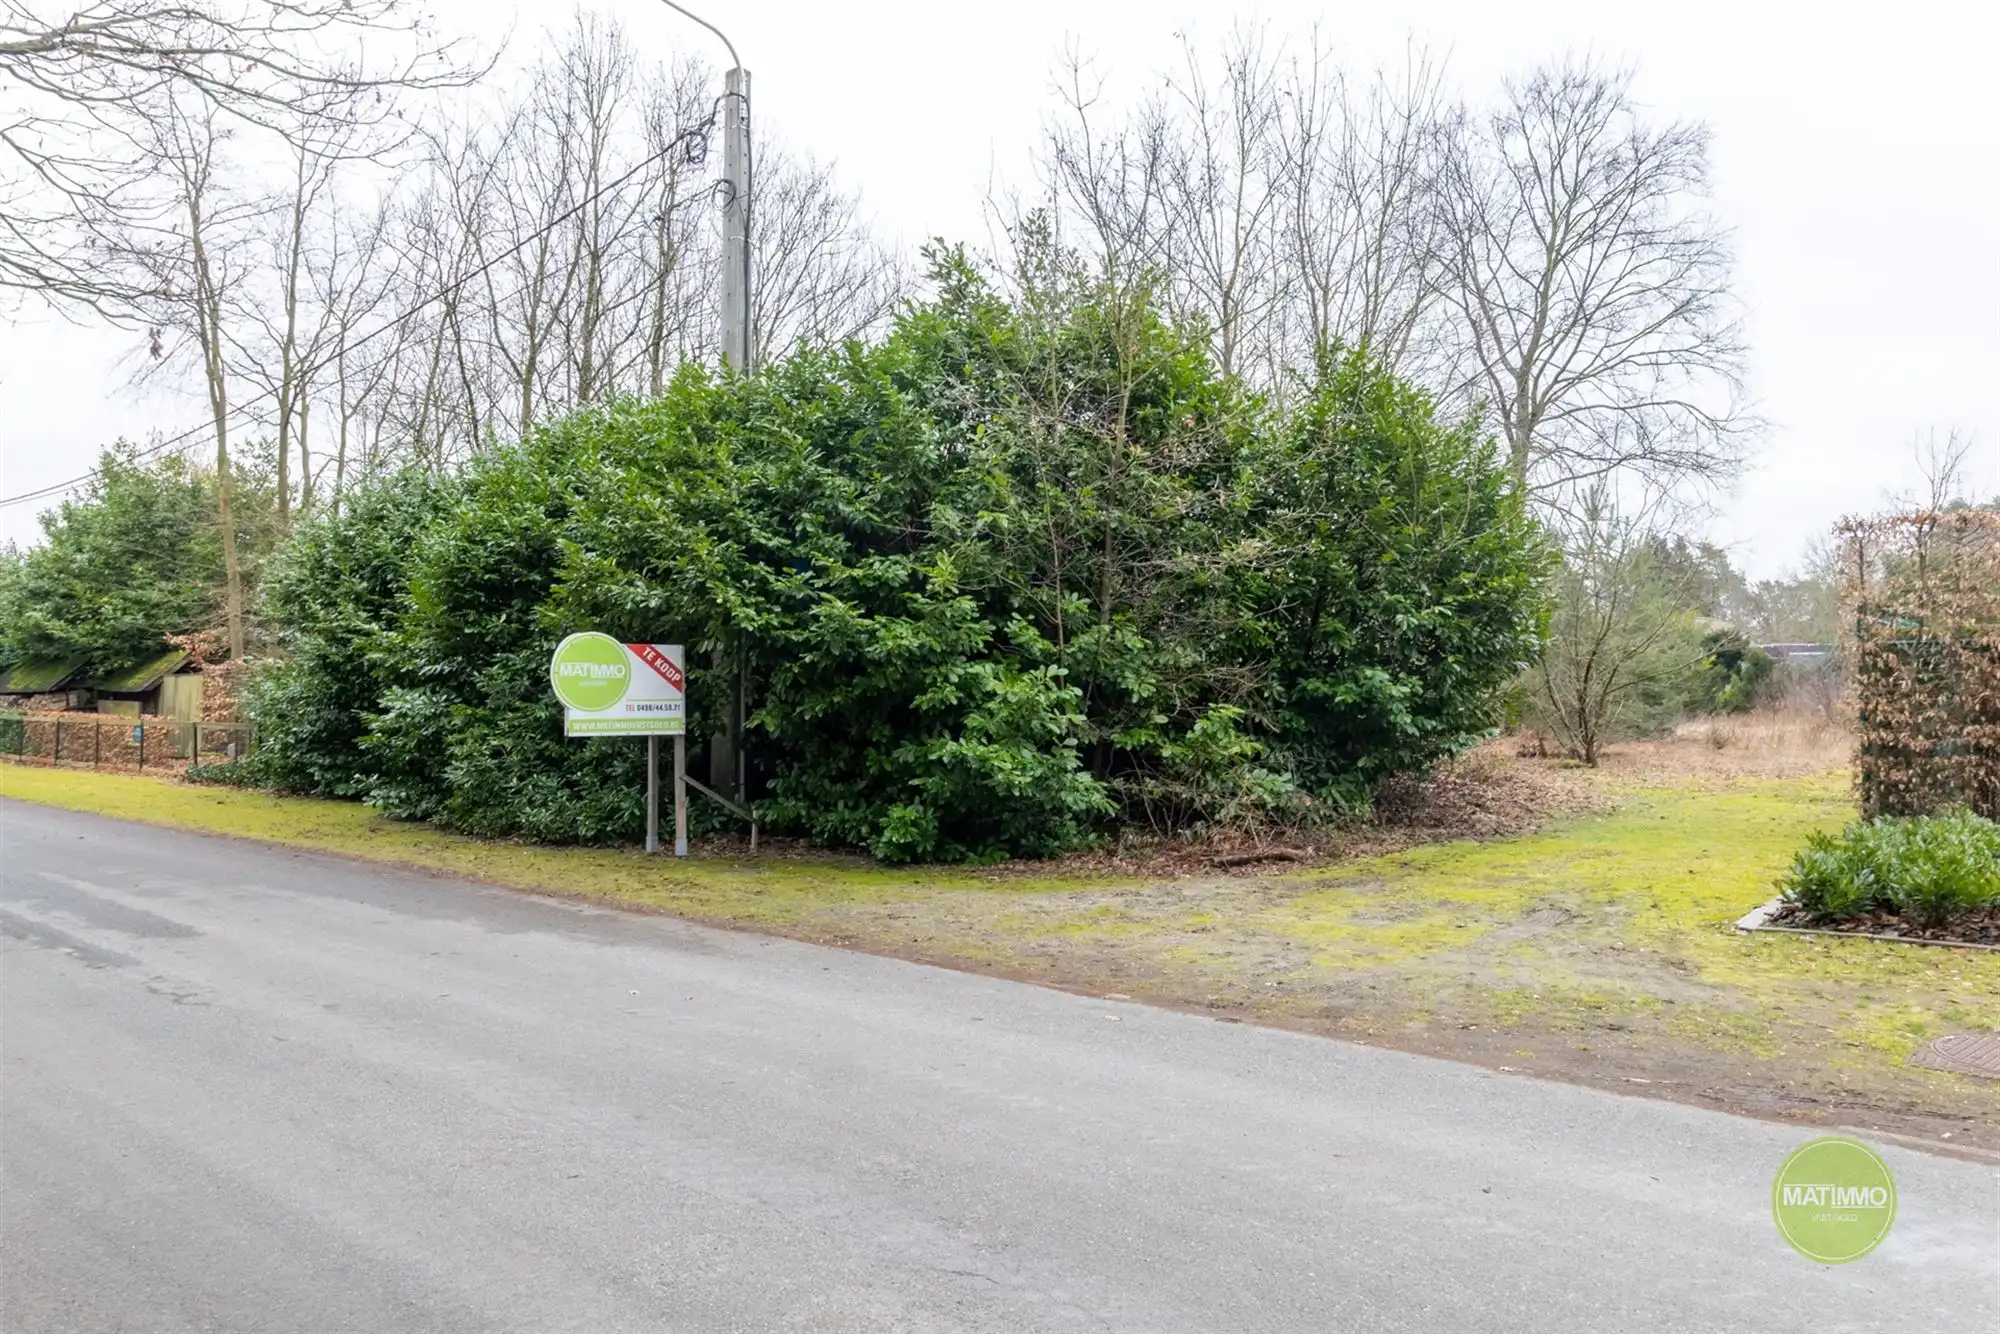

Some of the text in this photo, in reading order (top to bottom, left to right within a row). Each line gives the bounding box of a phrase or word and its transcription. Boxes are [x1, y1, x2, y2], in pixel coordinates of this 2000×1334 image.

[560, 663, 626, 678] MATIMMO
[643, 646, 681, 681] TE KOOP
